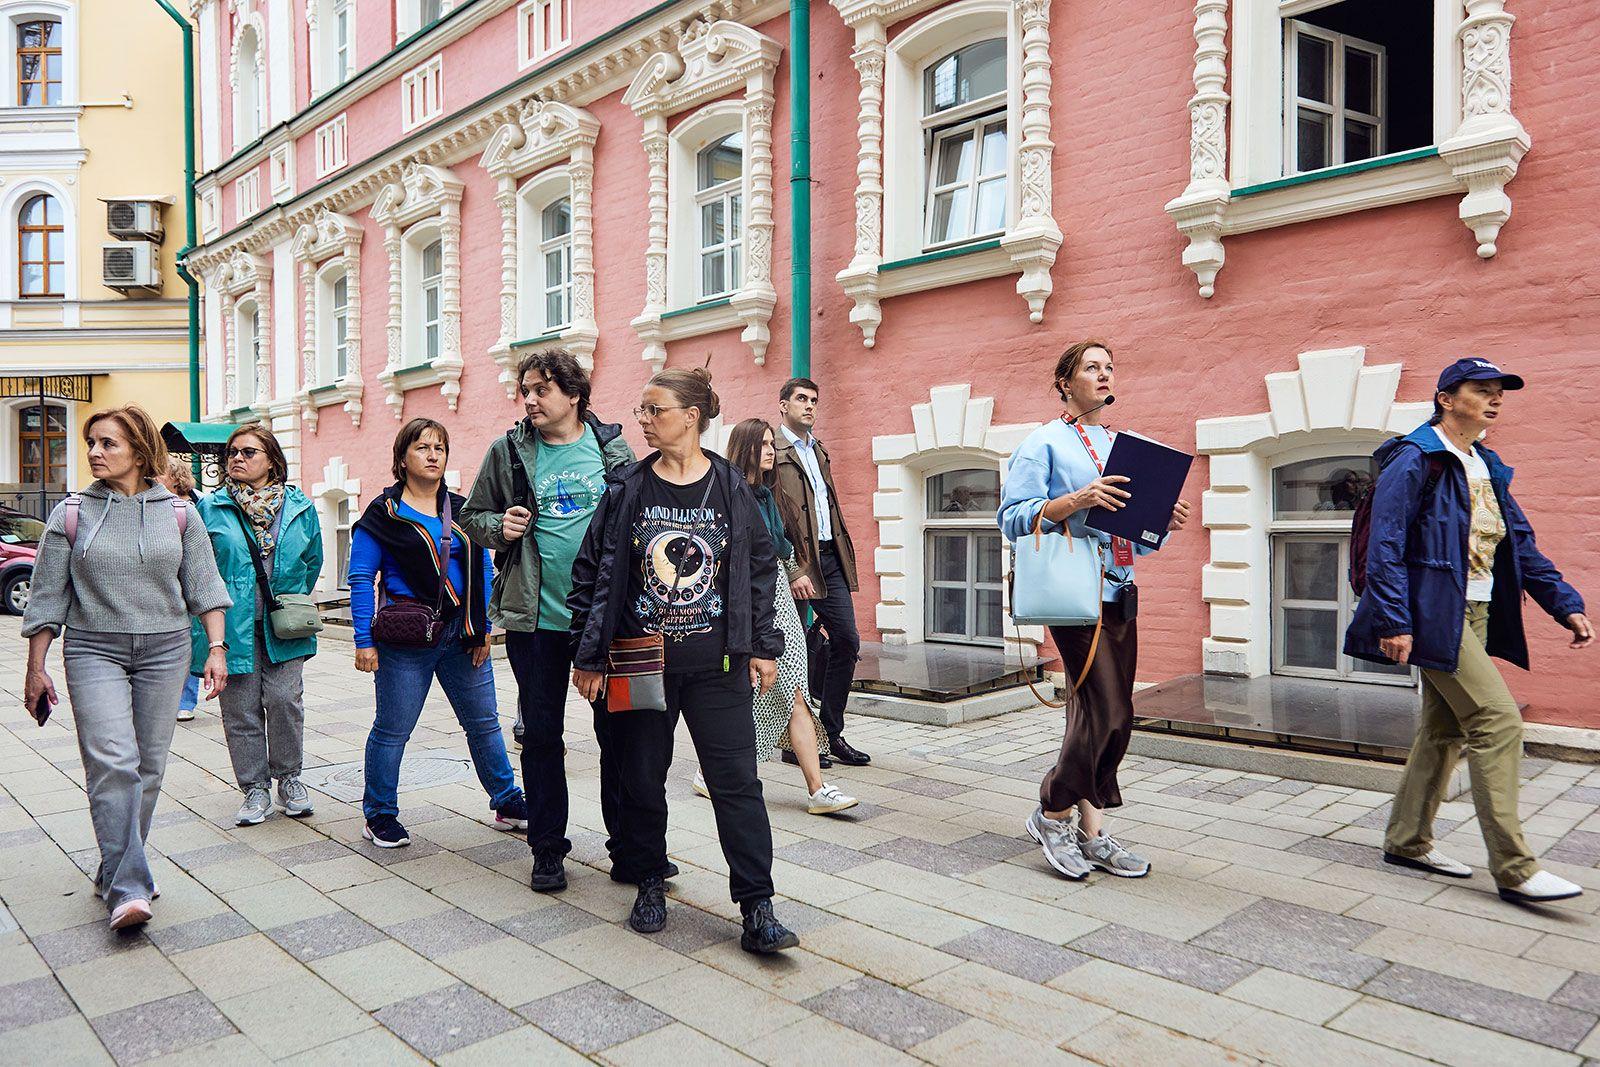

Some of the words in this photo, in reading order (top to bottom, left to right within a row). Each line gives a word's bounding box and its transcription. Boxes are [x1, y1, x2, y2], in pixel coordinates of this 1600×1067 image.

[562, 470, 598, 507] CALENDAR
[643, 505, 670, 520] MIND
[672, 507, 715, 523] ILLUSON
[679, 607, 702, 615] MOON
